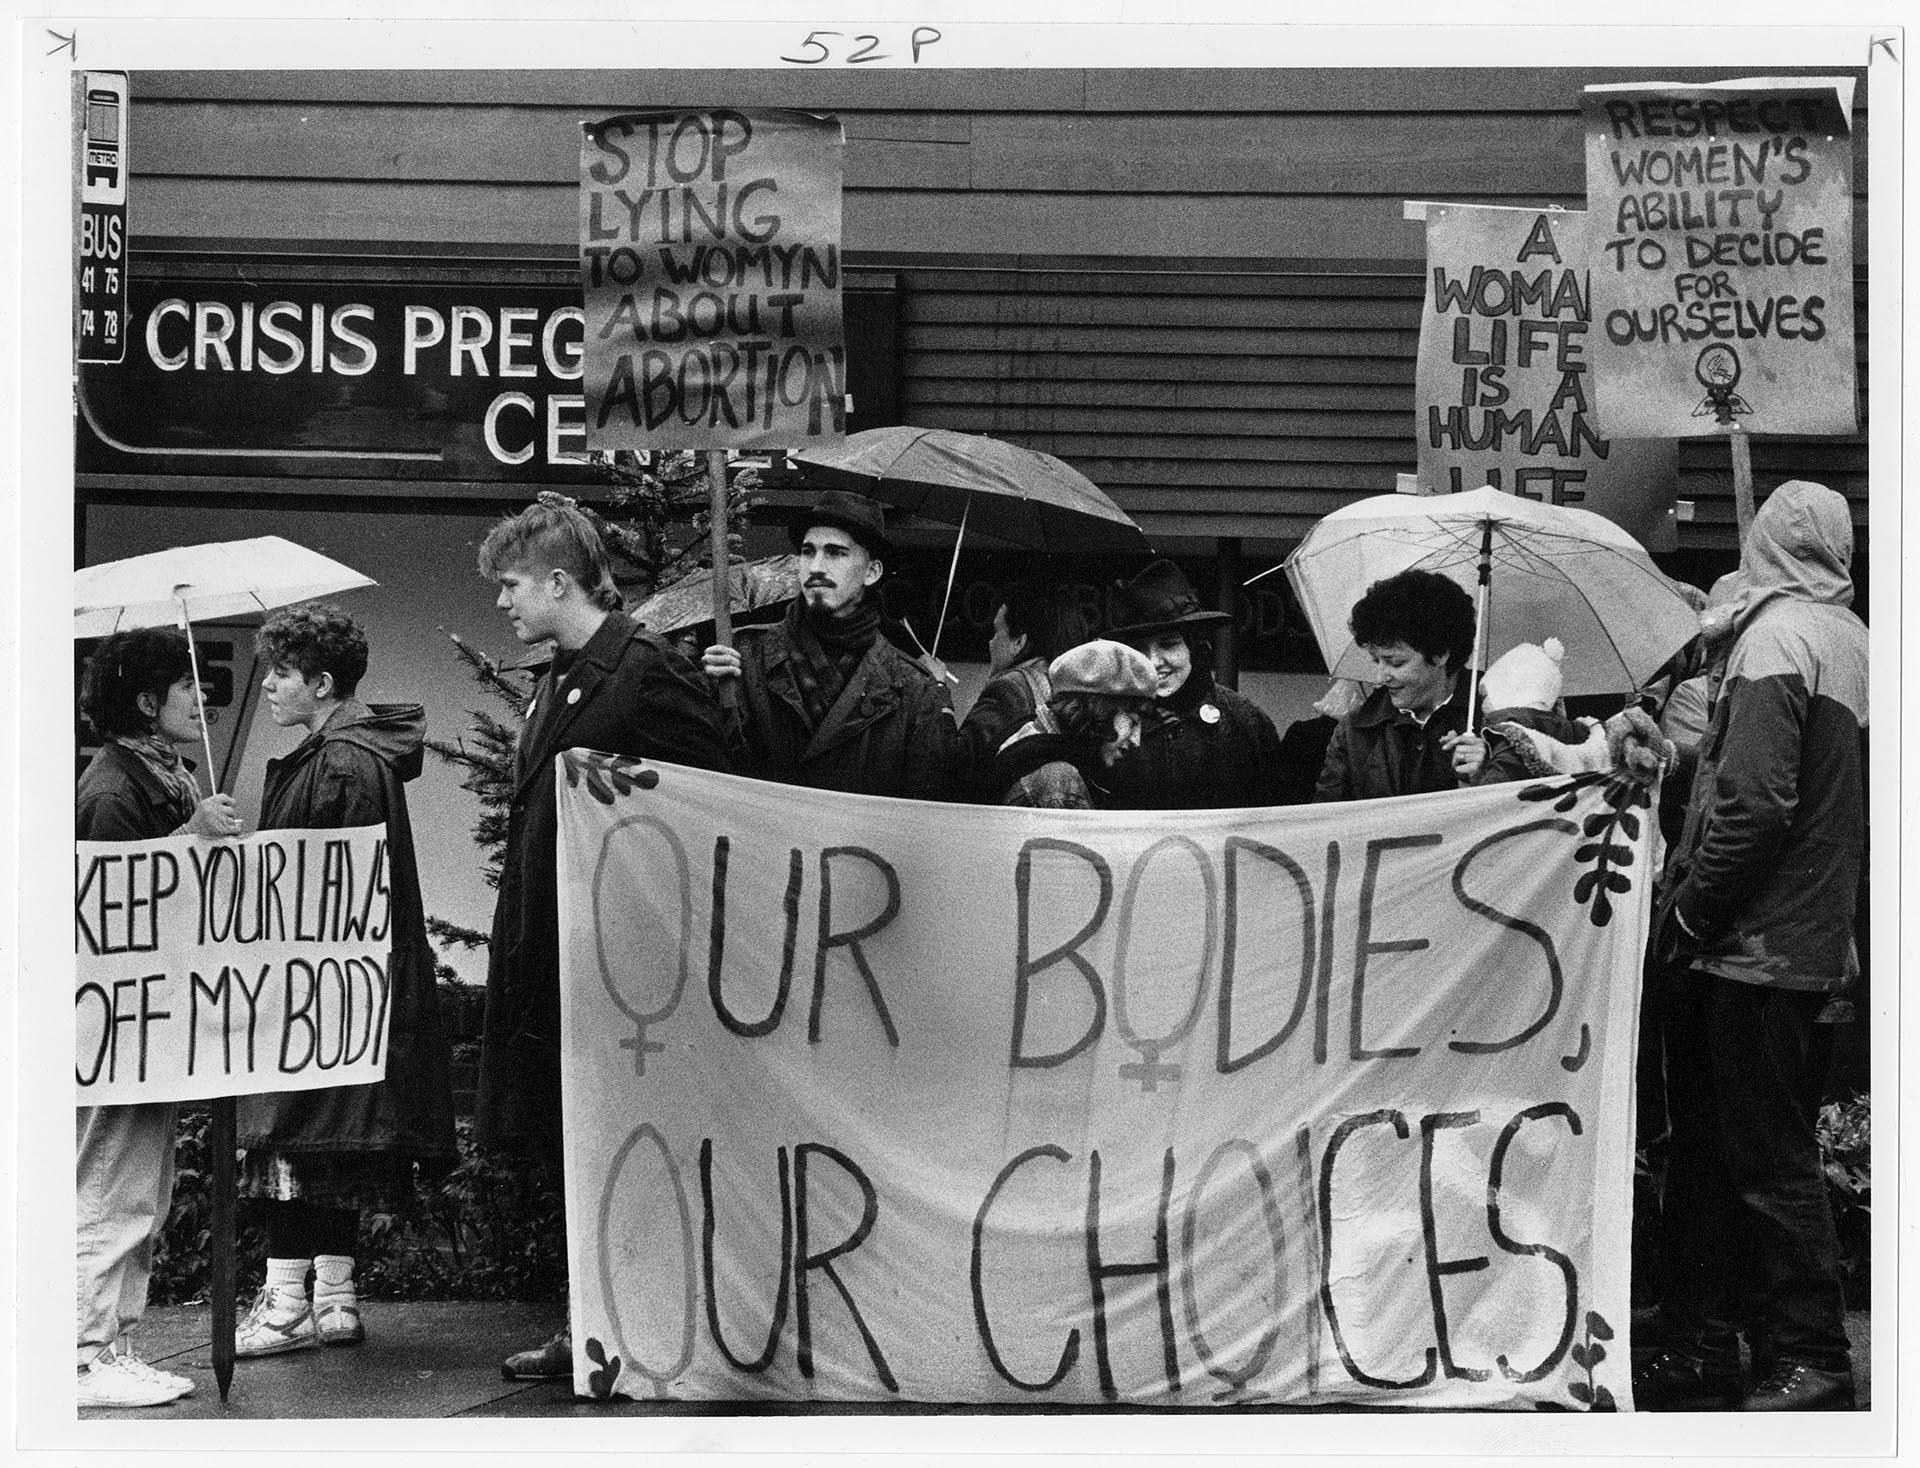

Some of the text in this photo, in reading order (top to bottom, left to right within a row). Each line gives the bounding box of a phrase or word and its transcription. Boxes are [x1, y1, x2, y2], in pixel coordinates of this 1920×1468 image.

[1605, 98, 1822, 139] RESPECT
[88, 151, 117, 165] METRO
[588, 109, 752, 186] STOP
[1610, 136, 1812, 187] WOMEN'S
[589, 178, 782, 244] LYING
[1616, 188, 1784, 233] ABILITY
[80, 213, 122, 260] BUS
[1516, 214, 1562, 263] A
[1605, 228, 1829, 271] TO DECIDE
[82, 266, 119, 295] 41 75
[584, 242, 839, 289] TO WOMYN
[1674, 271, 1738, 302] FOR
[600, 287, 805, 343] ABOUT
[1434, 266, 1592, 322] WOMA
[82, 309, 118, 337] 74 78
[145, 299, 585, 380] CRISIS PREG
[1453, 317, 1588, 372] LIFE
[1604, 295, 1828, 345] OURSELVES
[597, 341, 847, 436] ABORTION
[1462, 367, 1588, 412] IS A
[1428, 405, 1610, 460] HUMAN
[75, 839, 391, 956] KEEP YOUR LAWS
[592, 814, 1591, 1092] OUR BODIES,
[75, 952, 393, 1087] OFF MY BODY
[597, 1101, 1583, 1401] OUR CHOICES
